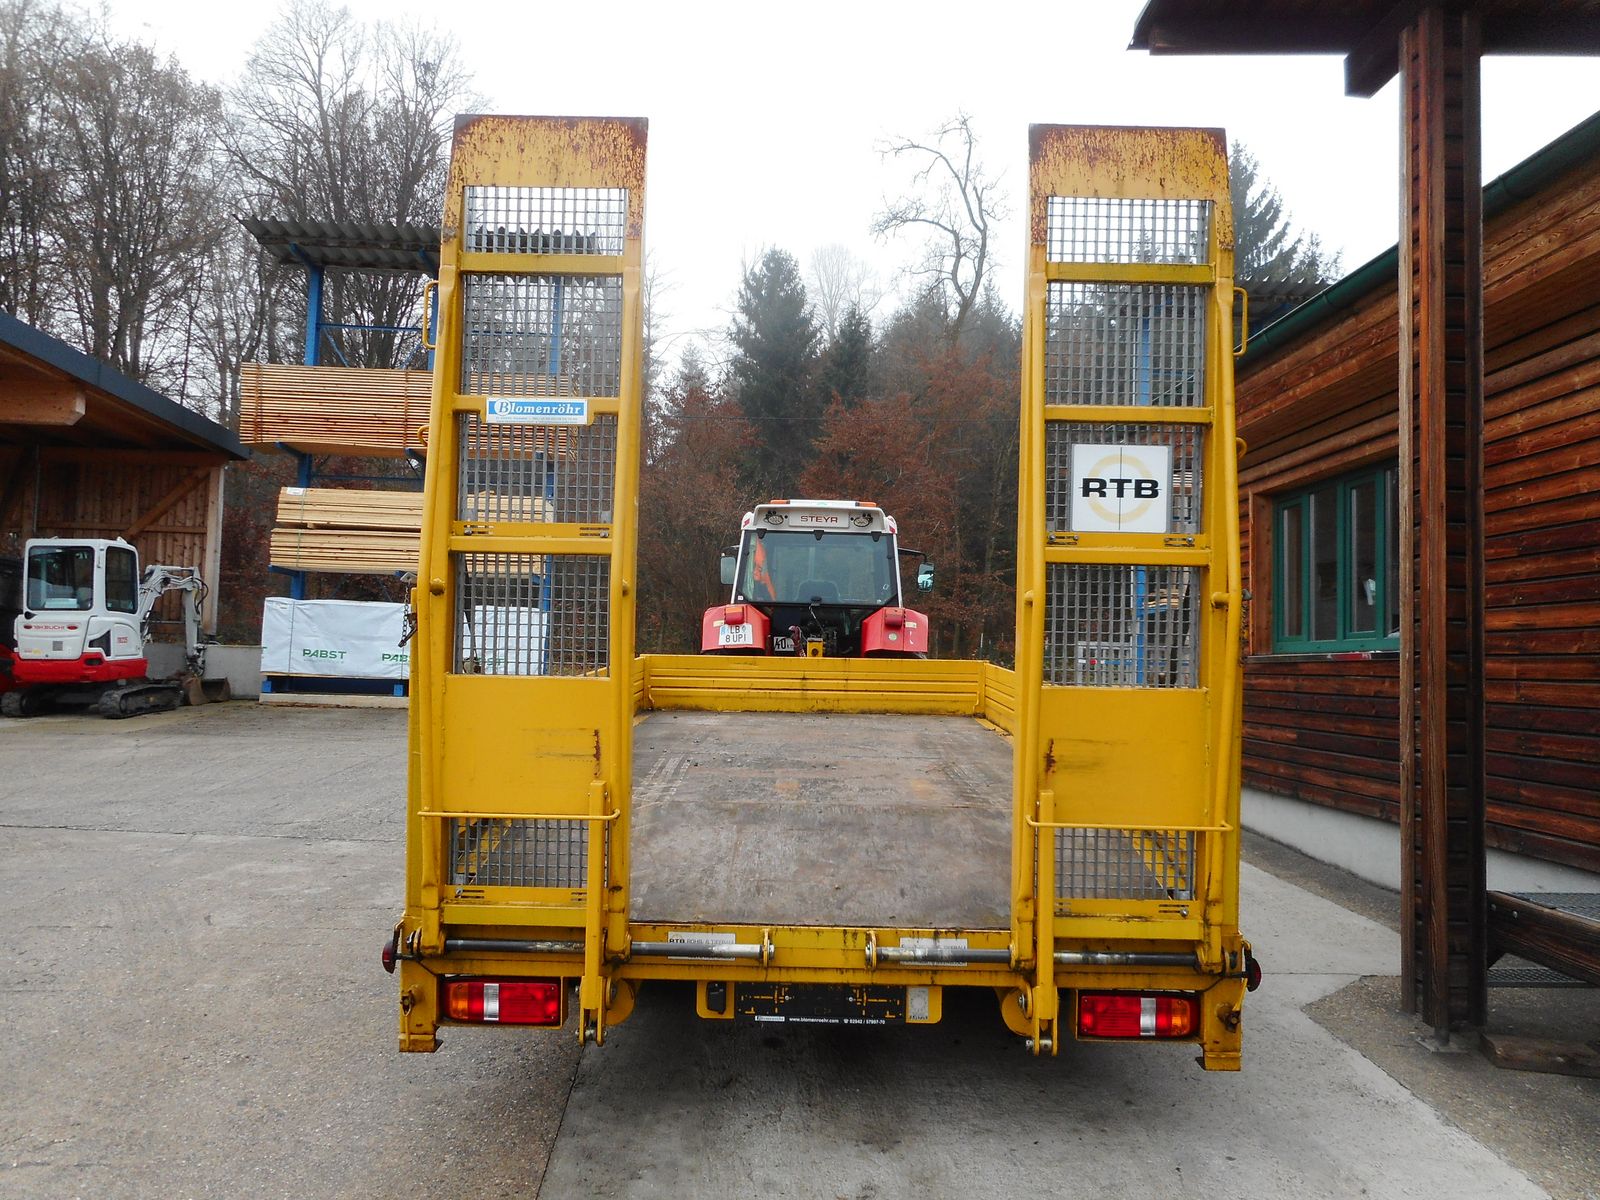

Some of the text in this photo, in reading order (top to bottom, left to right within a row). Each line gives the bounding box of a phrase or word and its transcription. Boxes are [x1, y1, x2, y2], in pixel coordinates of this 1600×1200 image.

[499, 401, 581, 415] Blomenröhr
[1082, 478, 1159, 499] RTB
[800, 515, 838, 523] STEYR
[730, 625, 741, 634] LB
[775, 637, 787, 649] 40
[302, 648, 347, 660] PABST
